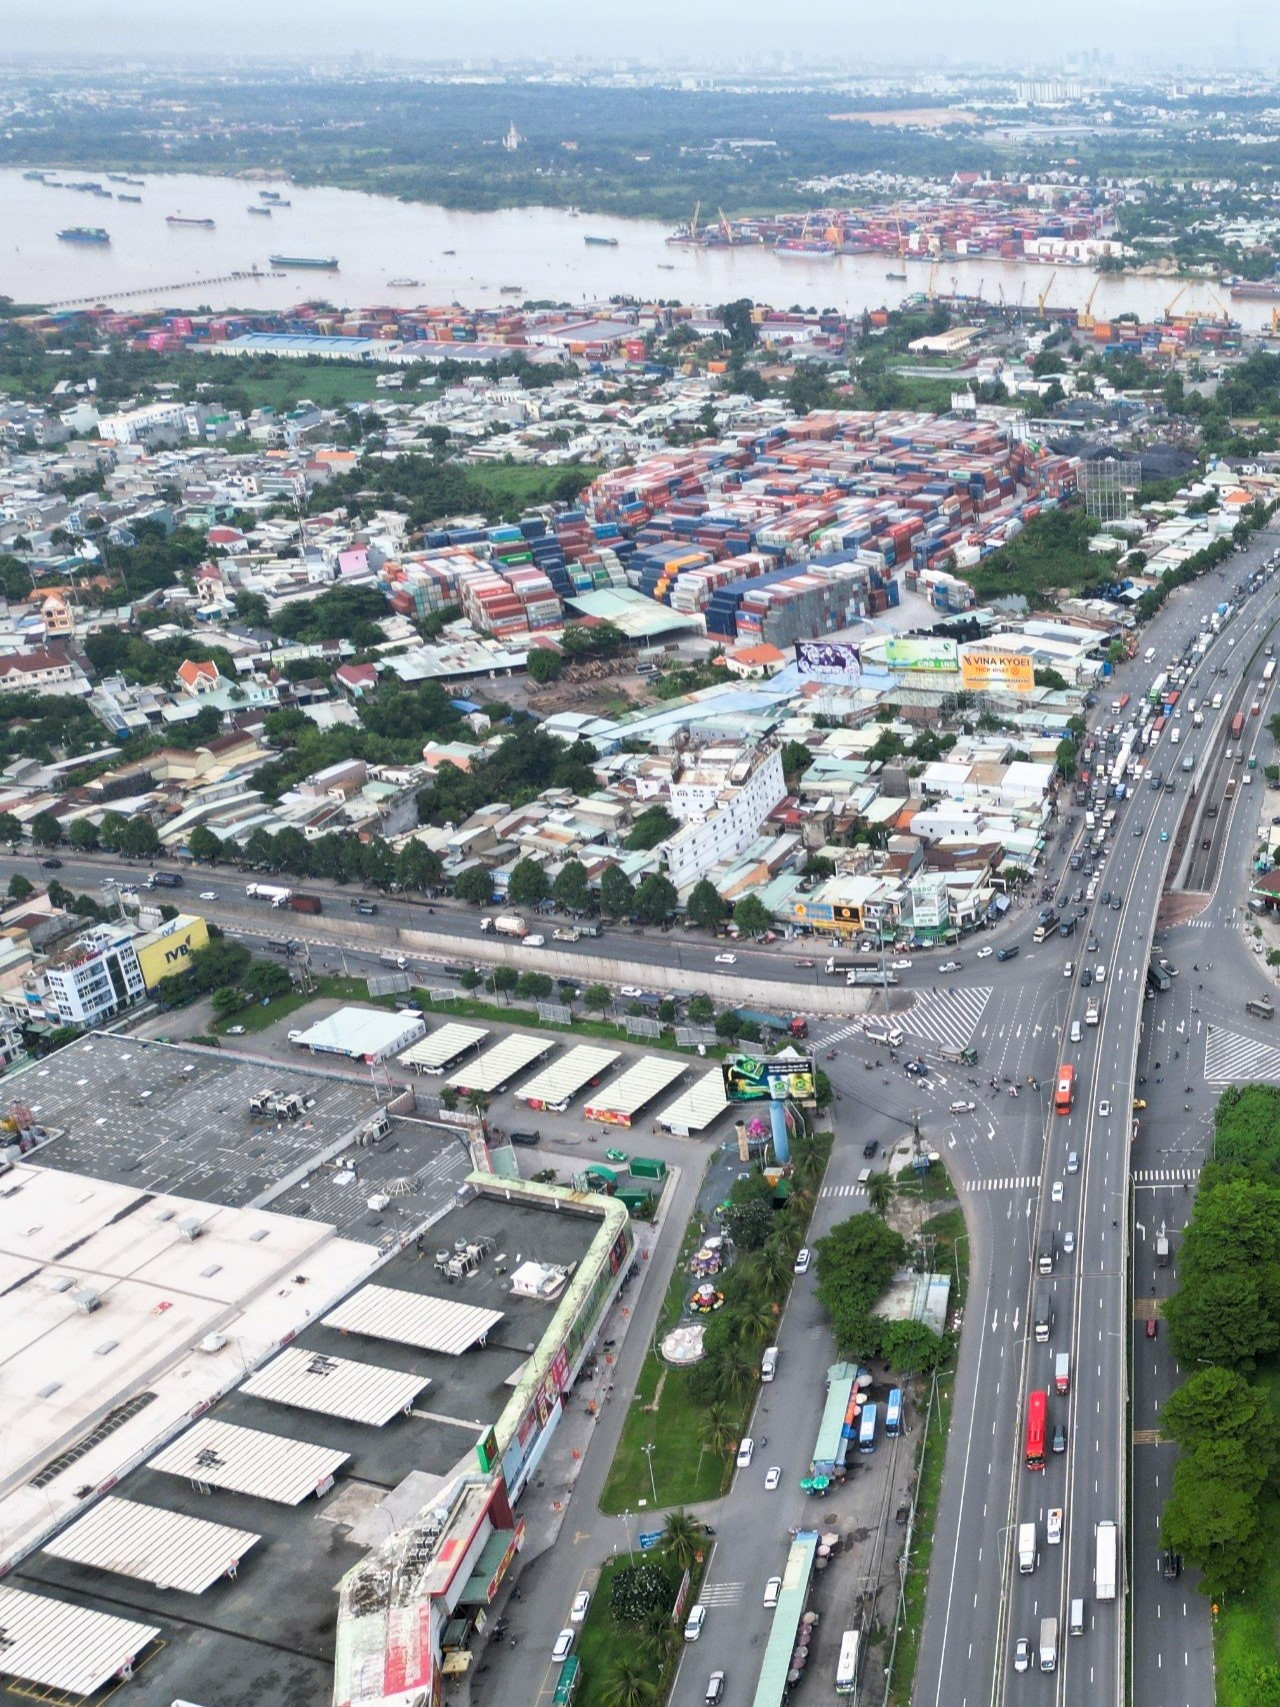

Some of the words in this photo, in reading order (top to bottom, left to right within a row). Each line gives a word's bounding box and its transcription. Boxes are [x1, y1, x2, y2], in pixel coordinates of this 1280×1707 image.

[973, 657, 997, 665] VINA
[1000, 658, 1030, 667] KYOEI
[164, 943, 190, 964] IVB
